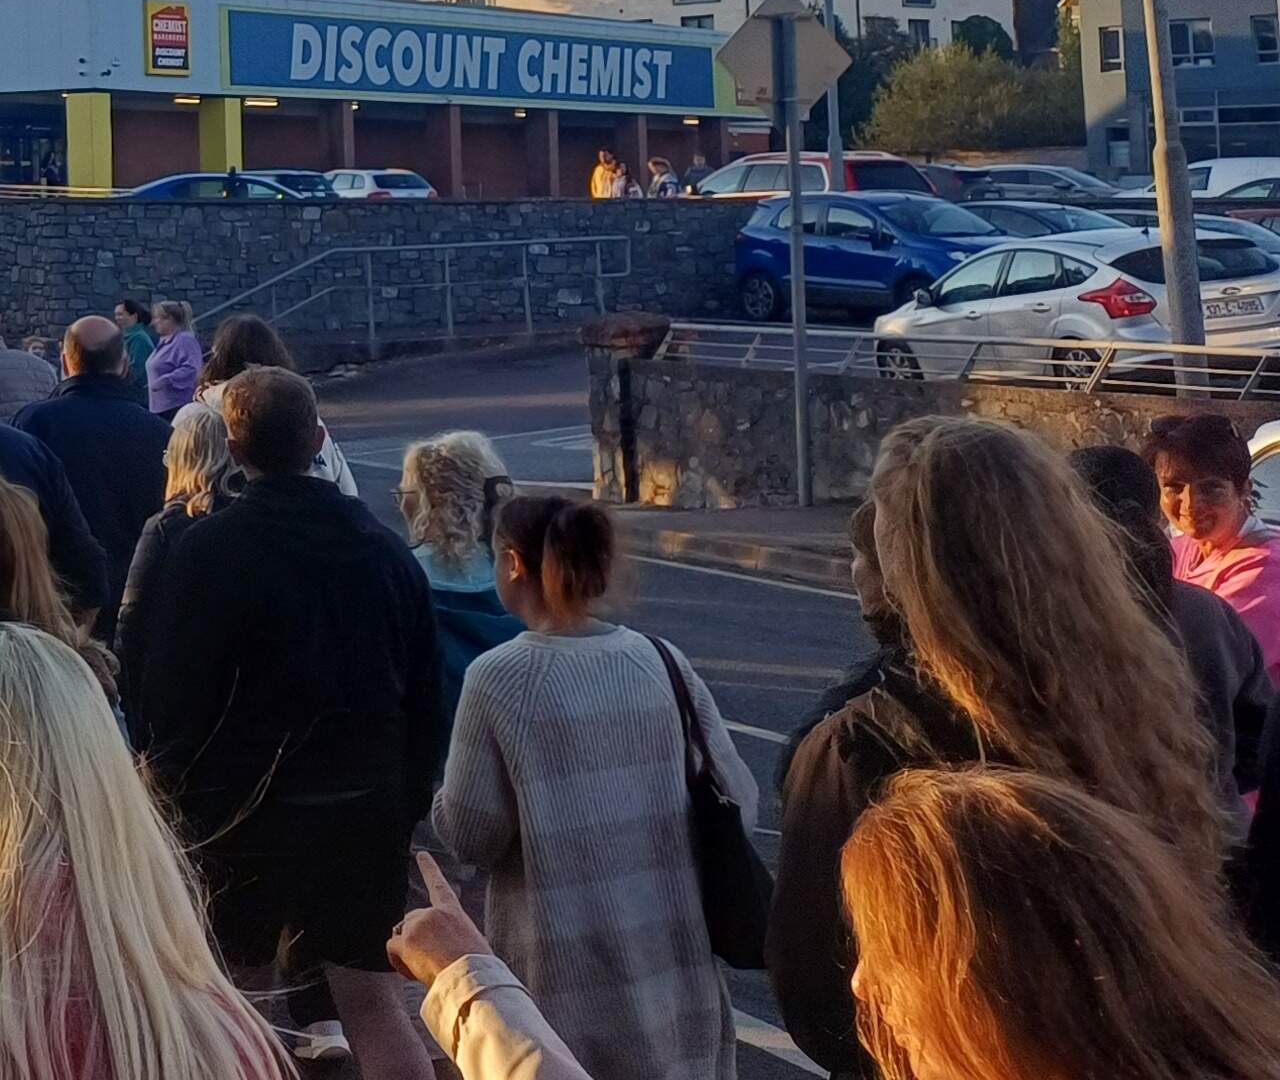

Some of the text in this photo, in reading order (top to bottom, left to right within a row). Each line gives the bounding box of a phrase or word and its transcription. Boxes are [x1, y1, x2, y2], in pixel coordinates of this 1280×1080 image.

[153, 19, 187, 34] CHEMIST
[155, 47, 186, 56] DISCOUNT
[157, 57, 184, 66] CHEMIST
[290, 22, 673, 99] DISCOUNT CHEMIST
